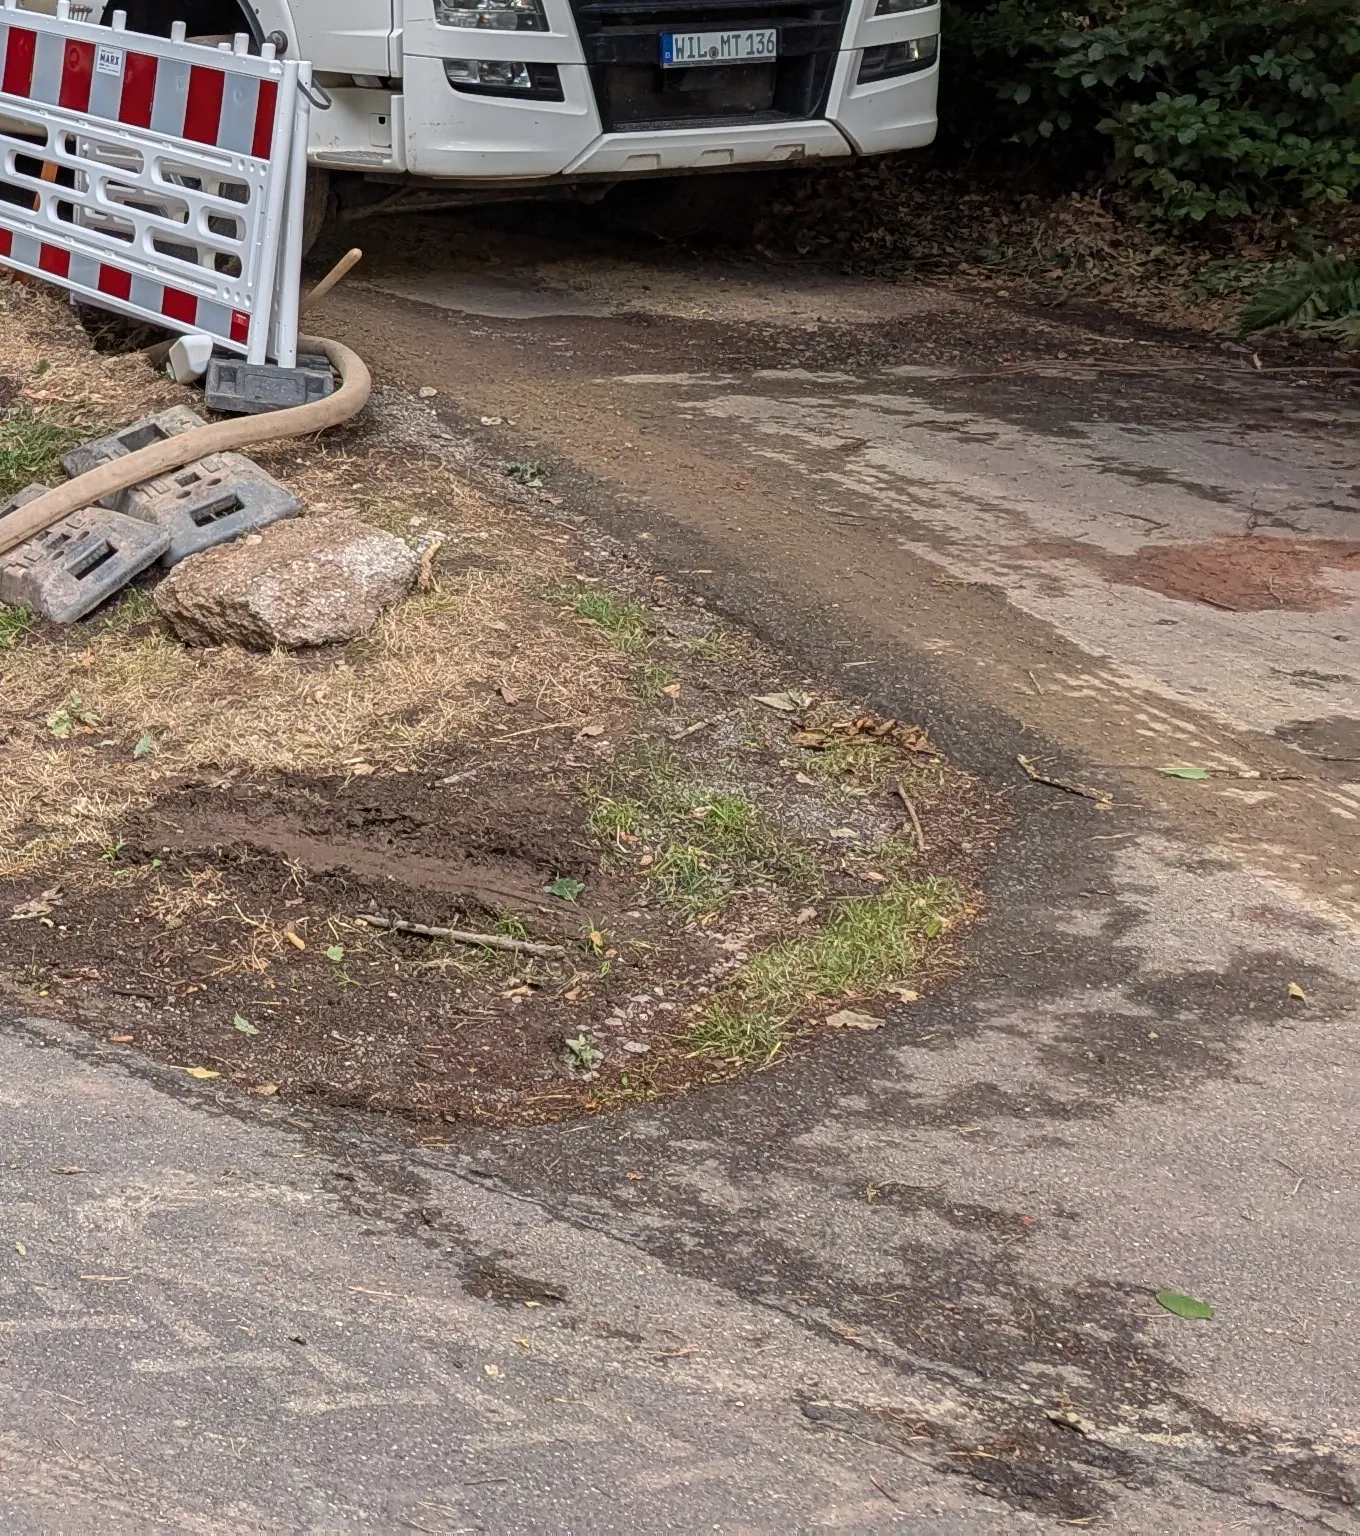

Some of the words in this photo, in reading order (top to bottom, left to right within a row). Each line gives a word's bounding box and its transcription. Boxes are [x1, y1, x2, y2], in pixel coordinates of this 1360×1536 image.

[674, 35, 708, 60] WIL
[720, 34, 742, 57] MT
[745, 31, 776, 56] 136
[100, 53, 120, 66] MARX
